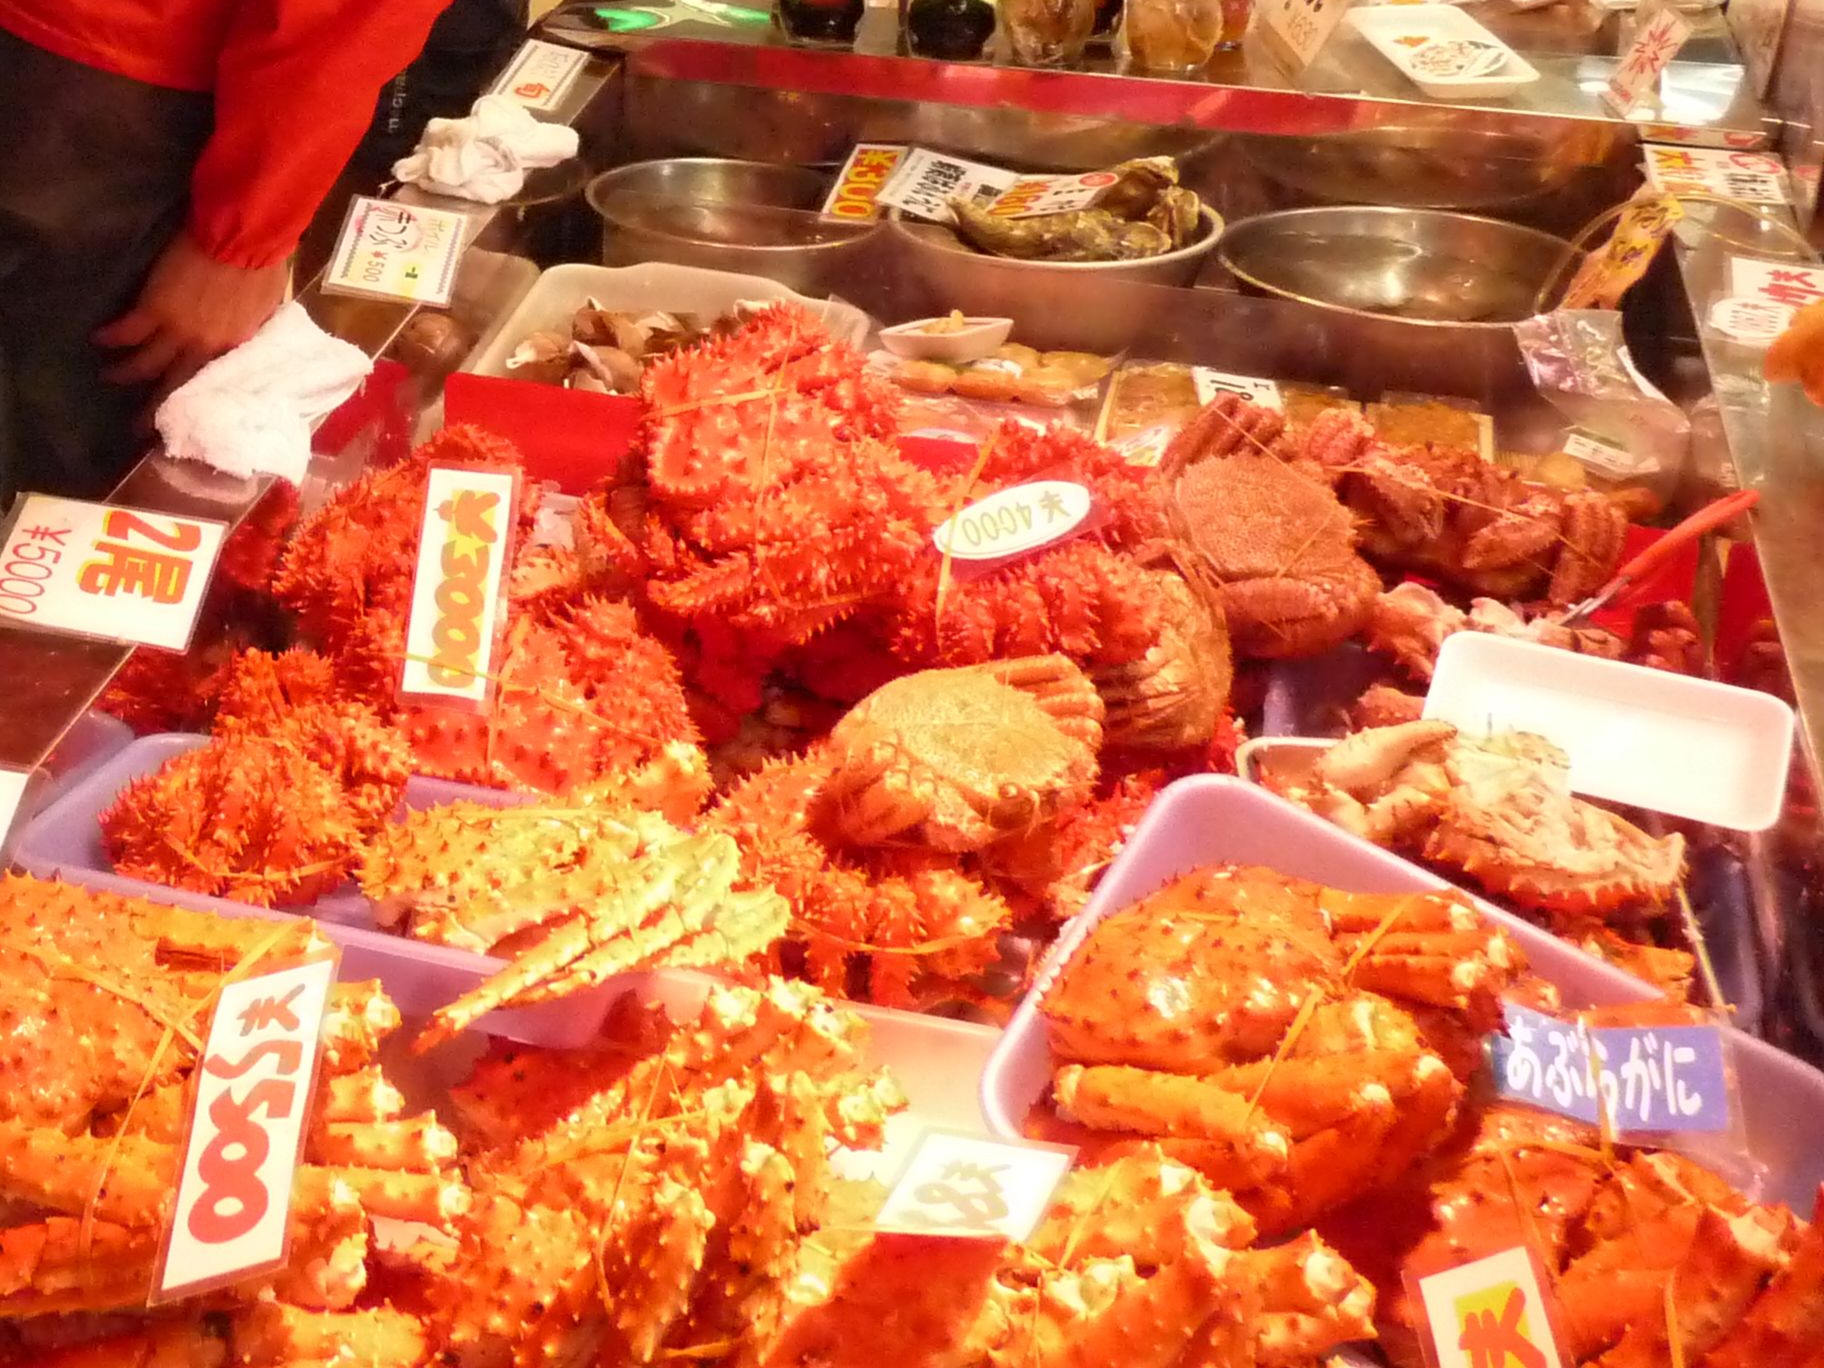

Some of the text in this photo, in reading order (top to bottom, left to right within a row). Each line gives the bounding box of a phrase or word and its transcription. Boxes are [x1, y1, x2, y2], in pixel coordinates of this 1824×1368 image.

[79, 510, 201, 605] 2尾
[427, 490, 500, 687] ¥3000
[186, 983, 306, 1245] ¥5500
[1507, 1015, 1704, 1125] あぶらがに
